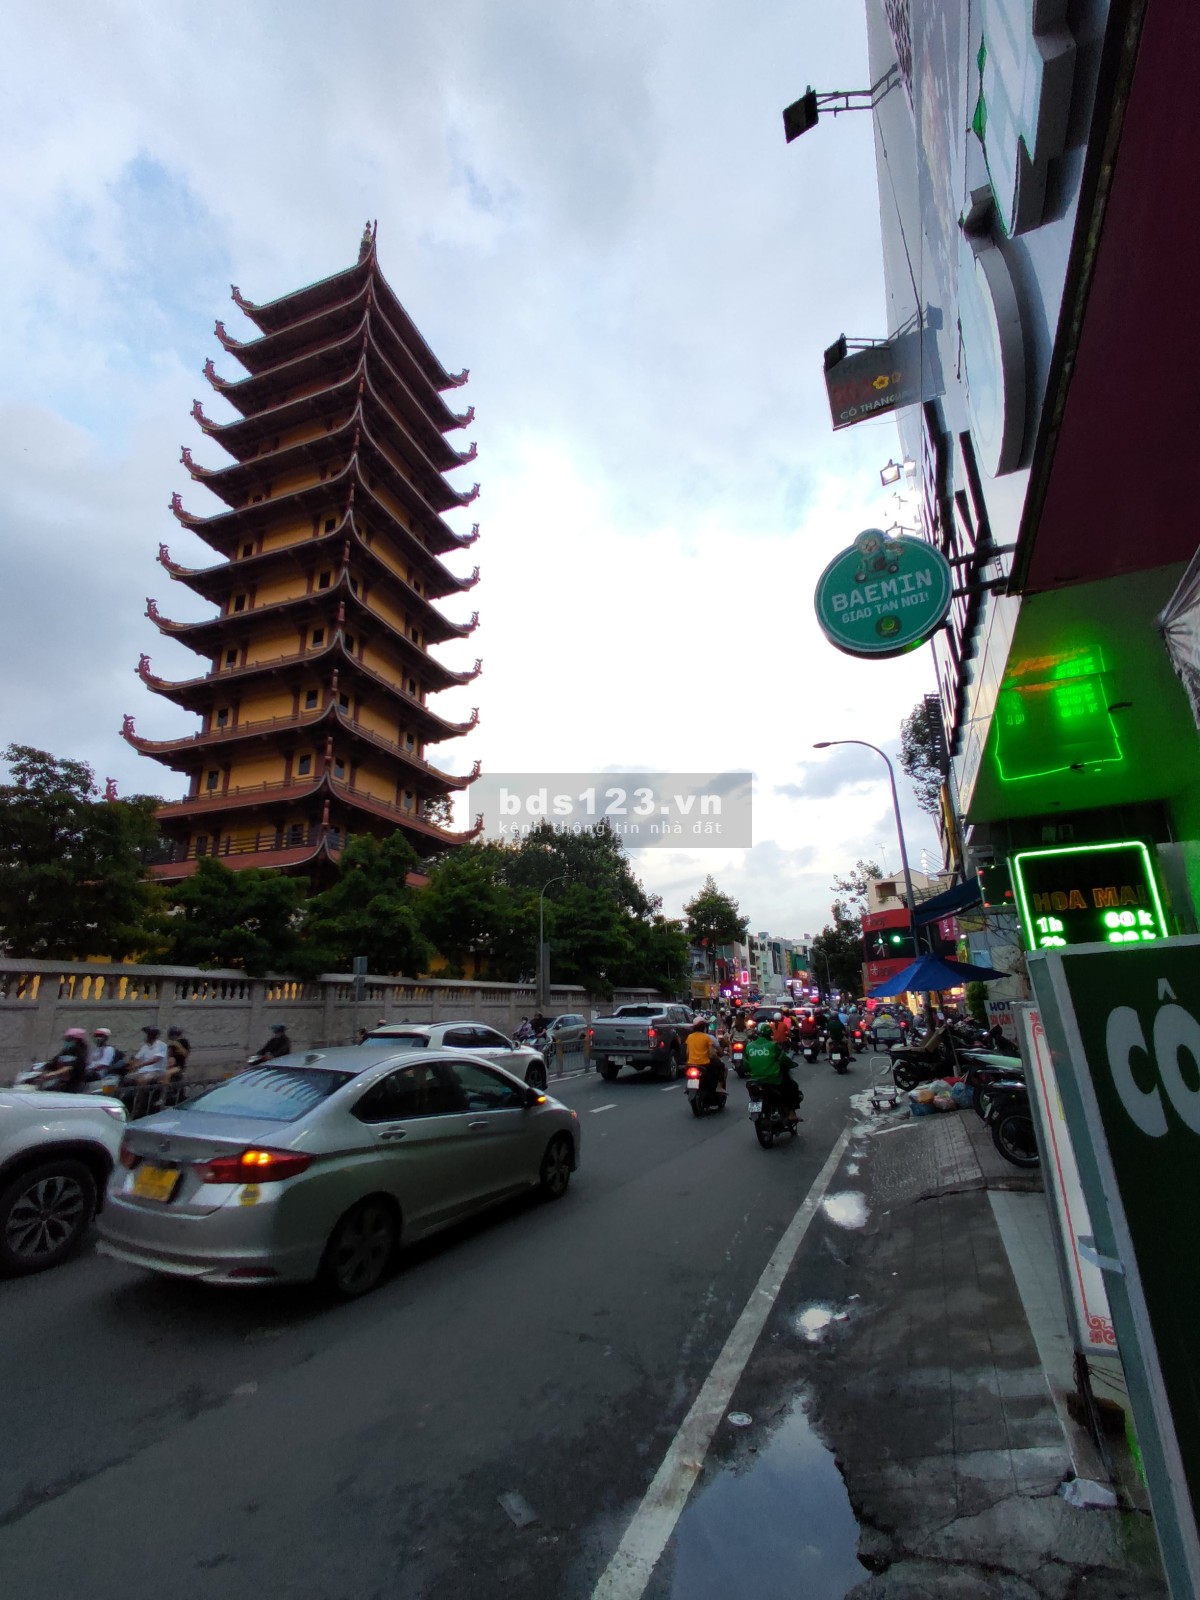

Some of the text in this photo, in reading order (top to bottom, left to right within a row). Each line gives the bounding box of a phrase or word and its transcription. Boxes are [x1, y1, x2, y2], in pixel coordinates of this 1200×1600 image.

[831, 568, 933, 612] BAEMIN
[841, 607, 872, 624] GIAO
[1033, 885, 1147, 912] HOA MAI
[1036, 916, 1064, 933] 1h
[749, 1048, 770, 1056] Grab
